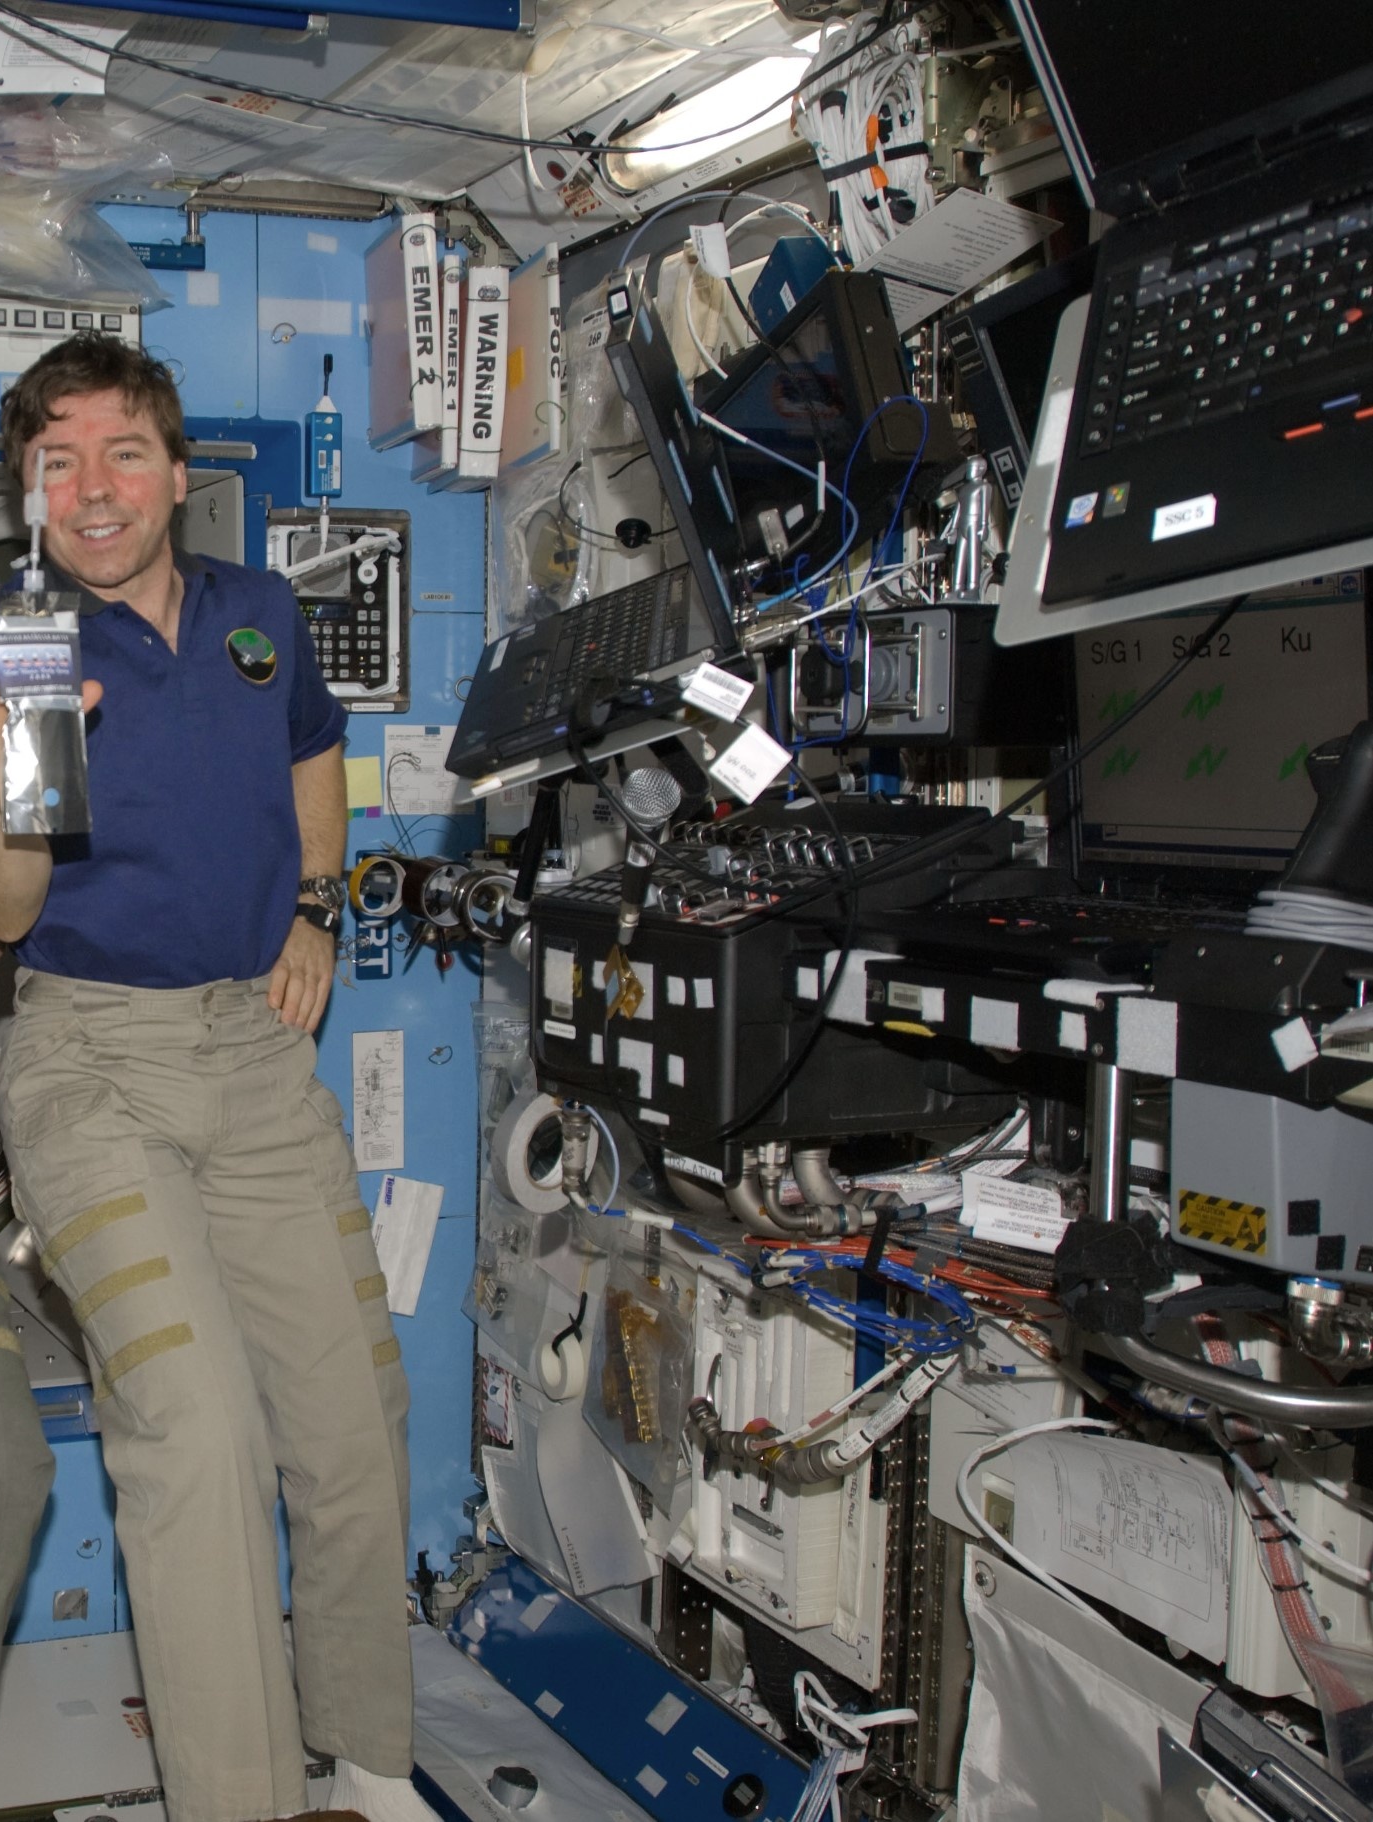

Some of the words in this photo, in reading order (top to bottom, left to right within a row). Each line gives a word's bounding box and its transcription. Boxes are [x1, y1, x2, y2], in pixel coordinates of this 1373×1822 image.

[412, 266, 433, 357] EMER
[447, 308, 458, 388] EMER
[550, 306, 561, 378] POC
[588, 331, 602, 347] 26P
[419, 367, 435, 385] 2
[473, 313, 499, 440] WARNING
[447, 399, 456, 410] 1
[1164, 510, 1192, 527] SSC
[1195, 507, 1204, 519] 5
[1091, 640, 1133, 665] S/G
[1136, 640, 1142, 662] 1
[1172, 635, 1211, 659] S/G
[1219, 633, 1231, 657] 2
[1281, 626, 1311, 652] Ku
[384, 1177, 395, 1206] Tempo
[1195, 1203, 1225, 1217] CAUTION
